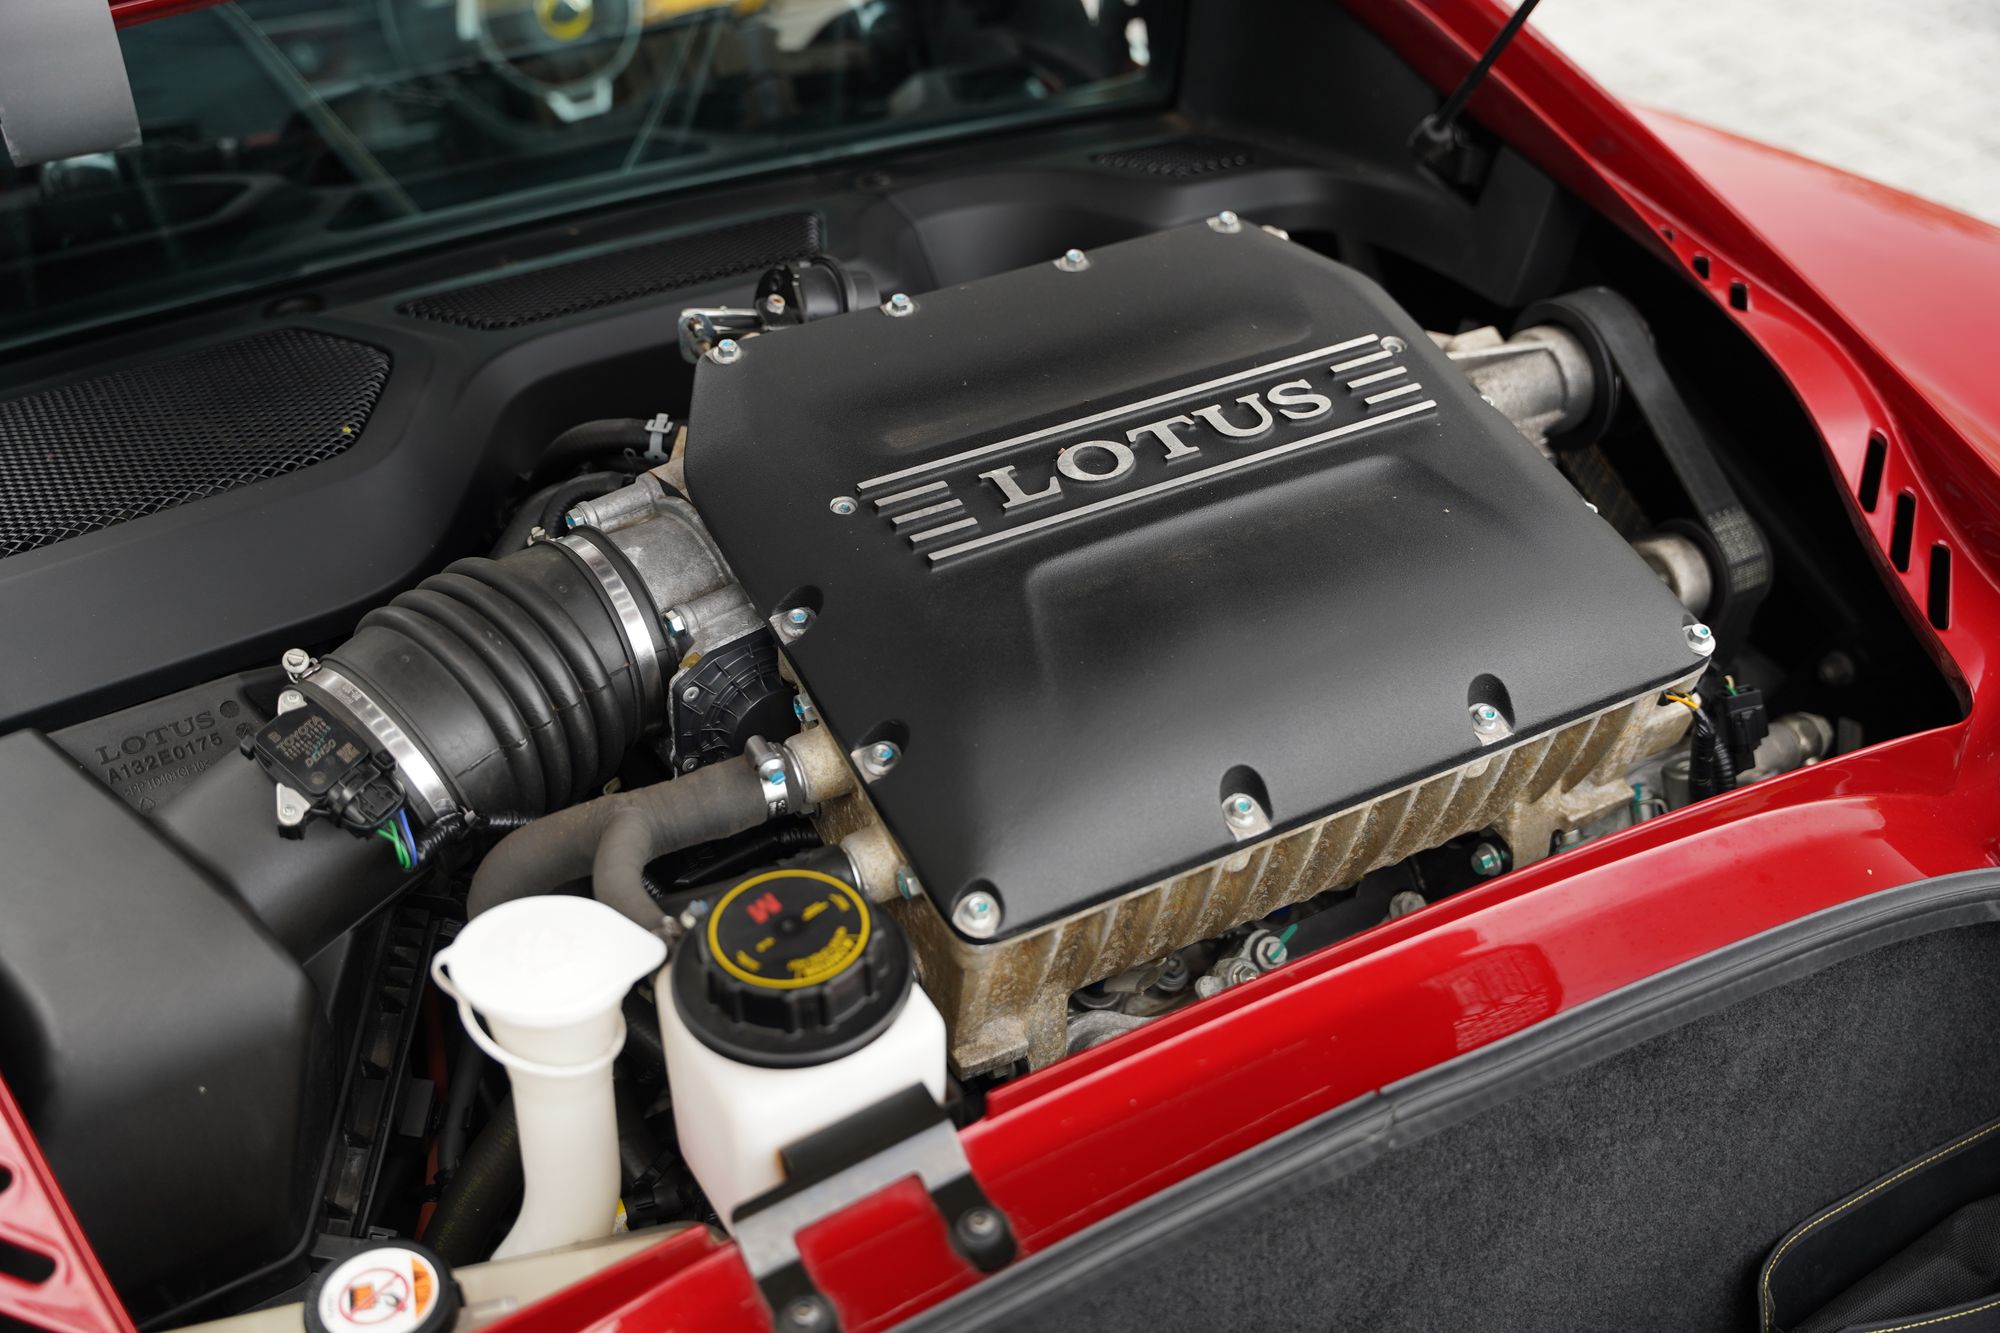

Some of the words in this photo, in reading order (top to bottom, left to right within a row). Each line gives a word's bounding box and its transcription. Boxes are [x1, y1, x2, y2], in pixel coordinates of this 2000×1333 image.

[977, 378, 1333, 512] LOTUS
[95, 711, 216, 765] LOTUS
[105, 732, 224, 785] A132E0175
[275, 716, 323, 752] TOYOTA
[304, 738, 337, 768] DENSO
